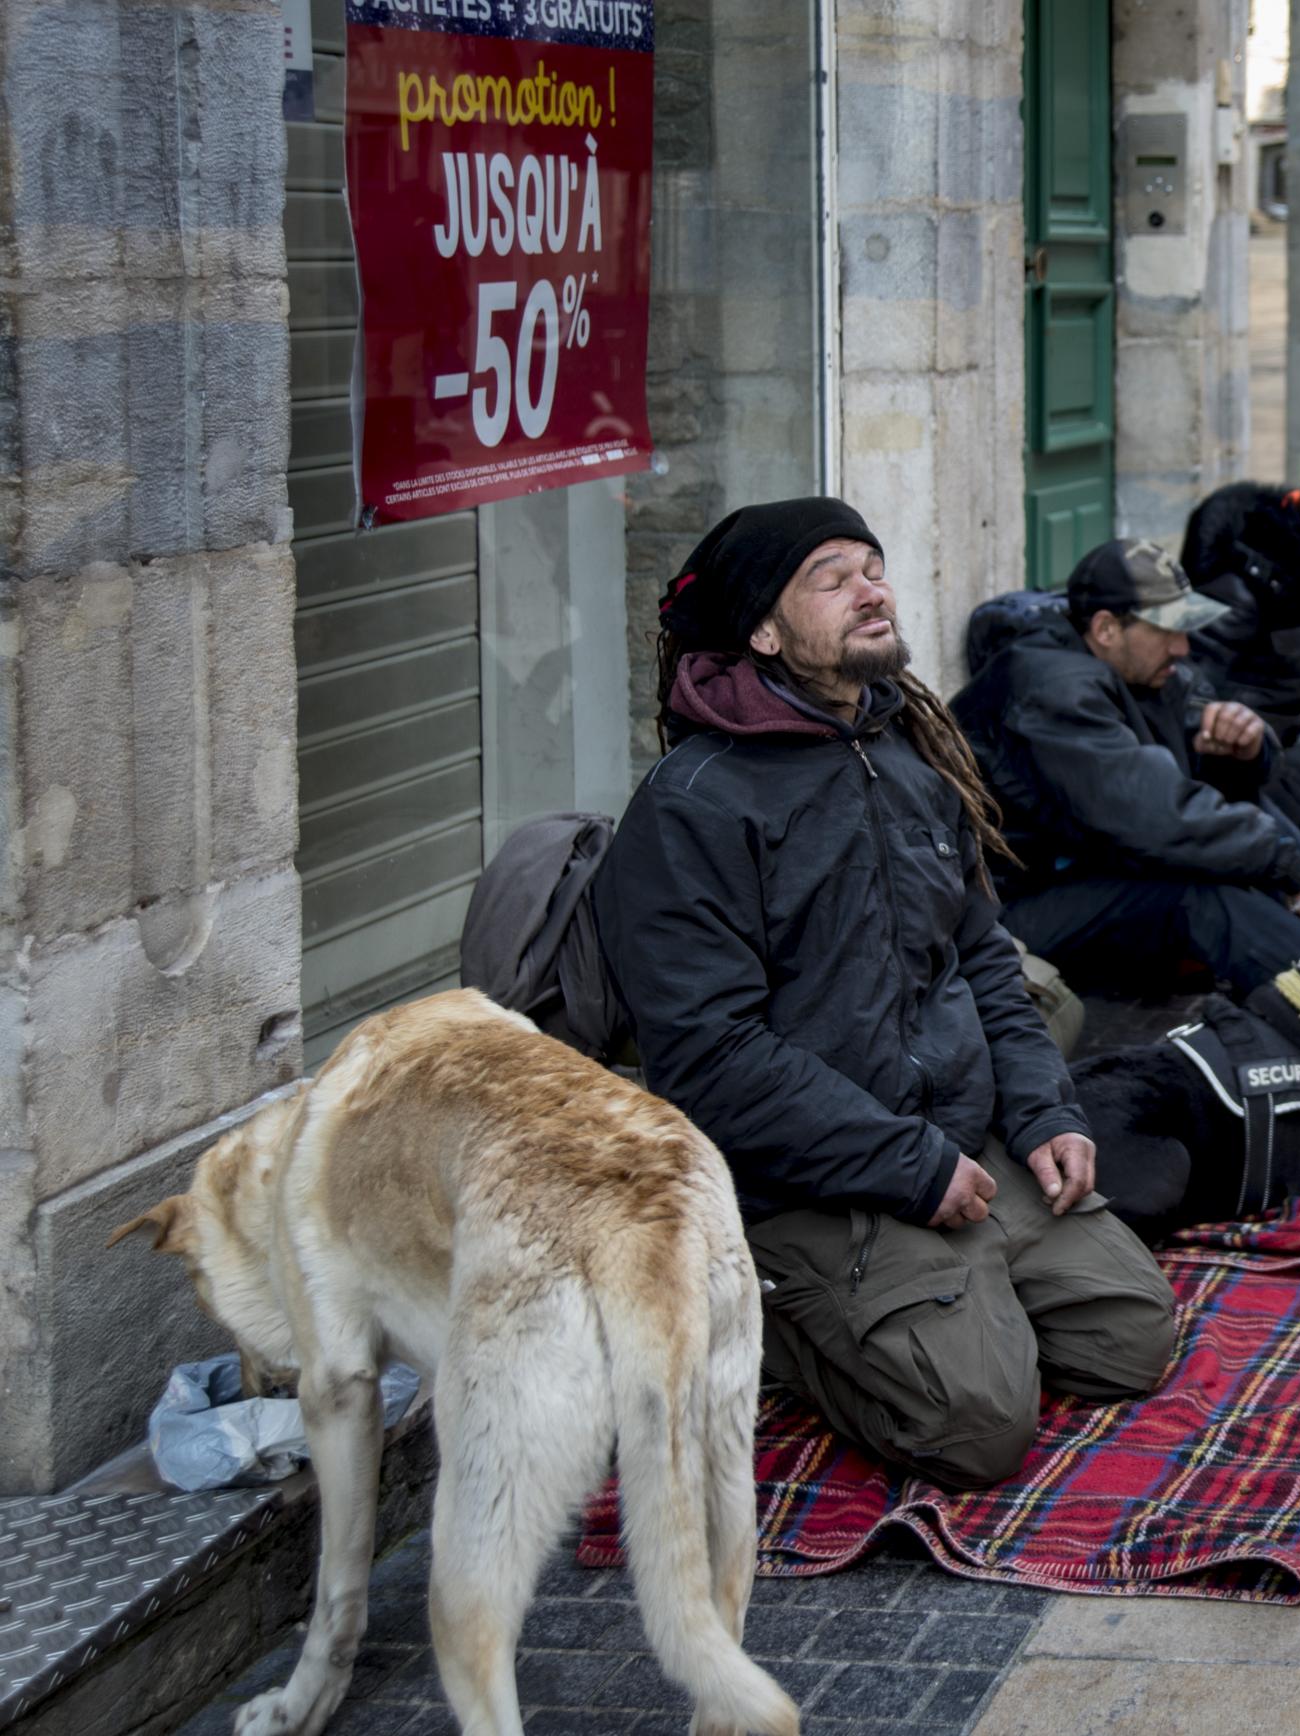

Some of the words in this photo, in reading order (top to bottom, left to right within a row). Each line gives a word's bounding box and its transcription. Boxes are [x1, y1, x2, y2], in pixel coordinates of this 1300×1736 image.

[523, 0, 538, 25] 3
[399, 60, 602, 151] promotion
[434, 133, 602, 258] JUSQU'À
